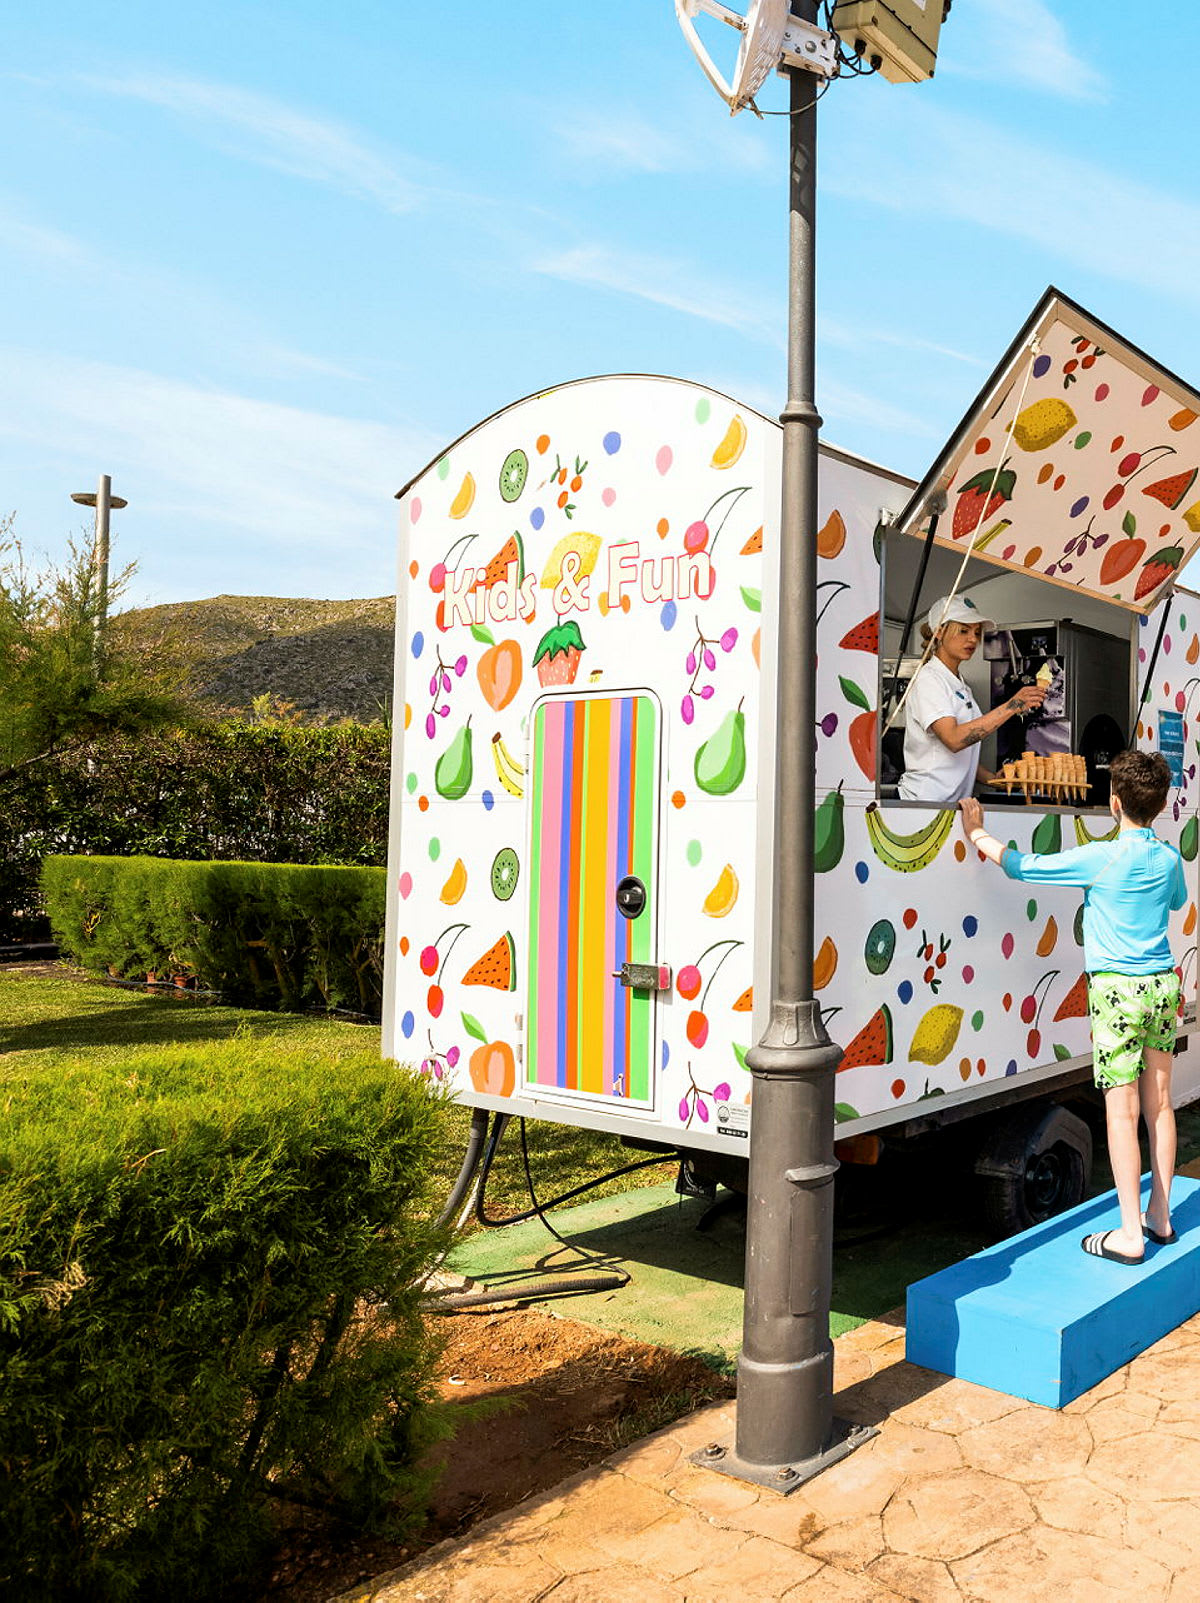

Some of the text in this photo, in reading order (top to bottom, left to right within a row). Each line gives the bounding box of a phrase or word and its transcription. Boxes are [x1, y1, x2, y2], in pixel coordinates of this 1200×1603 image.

[443, 541, 712, 629] Kids & Fun
